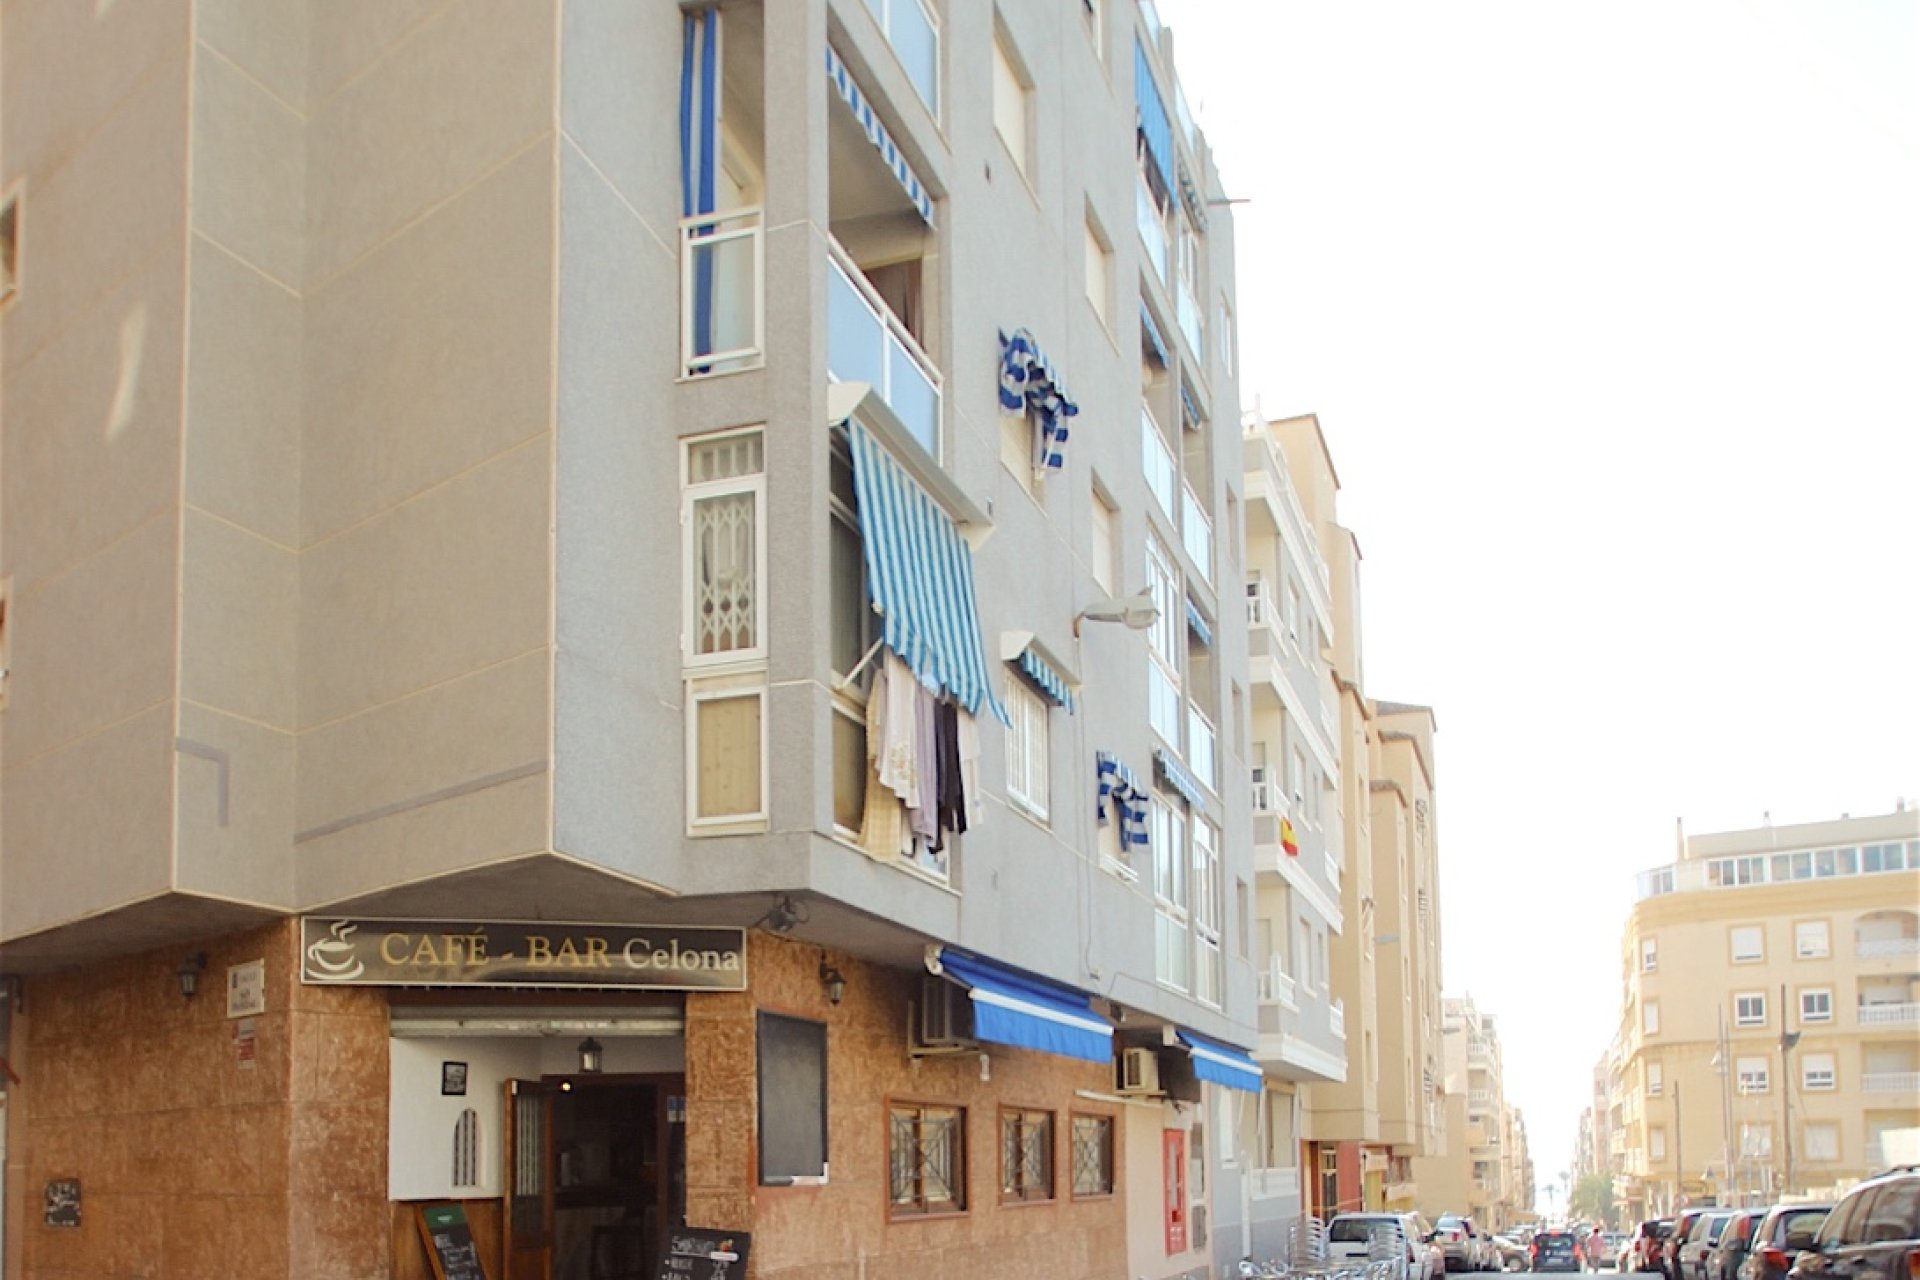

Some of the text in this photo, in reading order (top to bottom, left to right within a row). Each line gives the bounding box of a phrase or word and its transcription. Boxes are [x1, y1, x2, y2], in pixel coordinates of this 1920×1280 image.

[380, 926, 490, 966] CAFÉ
[527, 935, 612, 968] BAR
[622, 938, 740, 971] Celona
